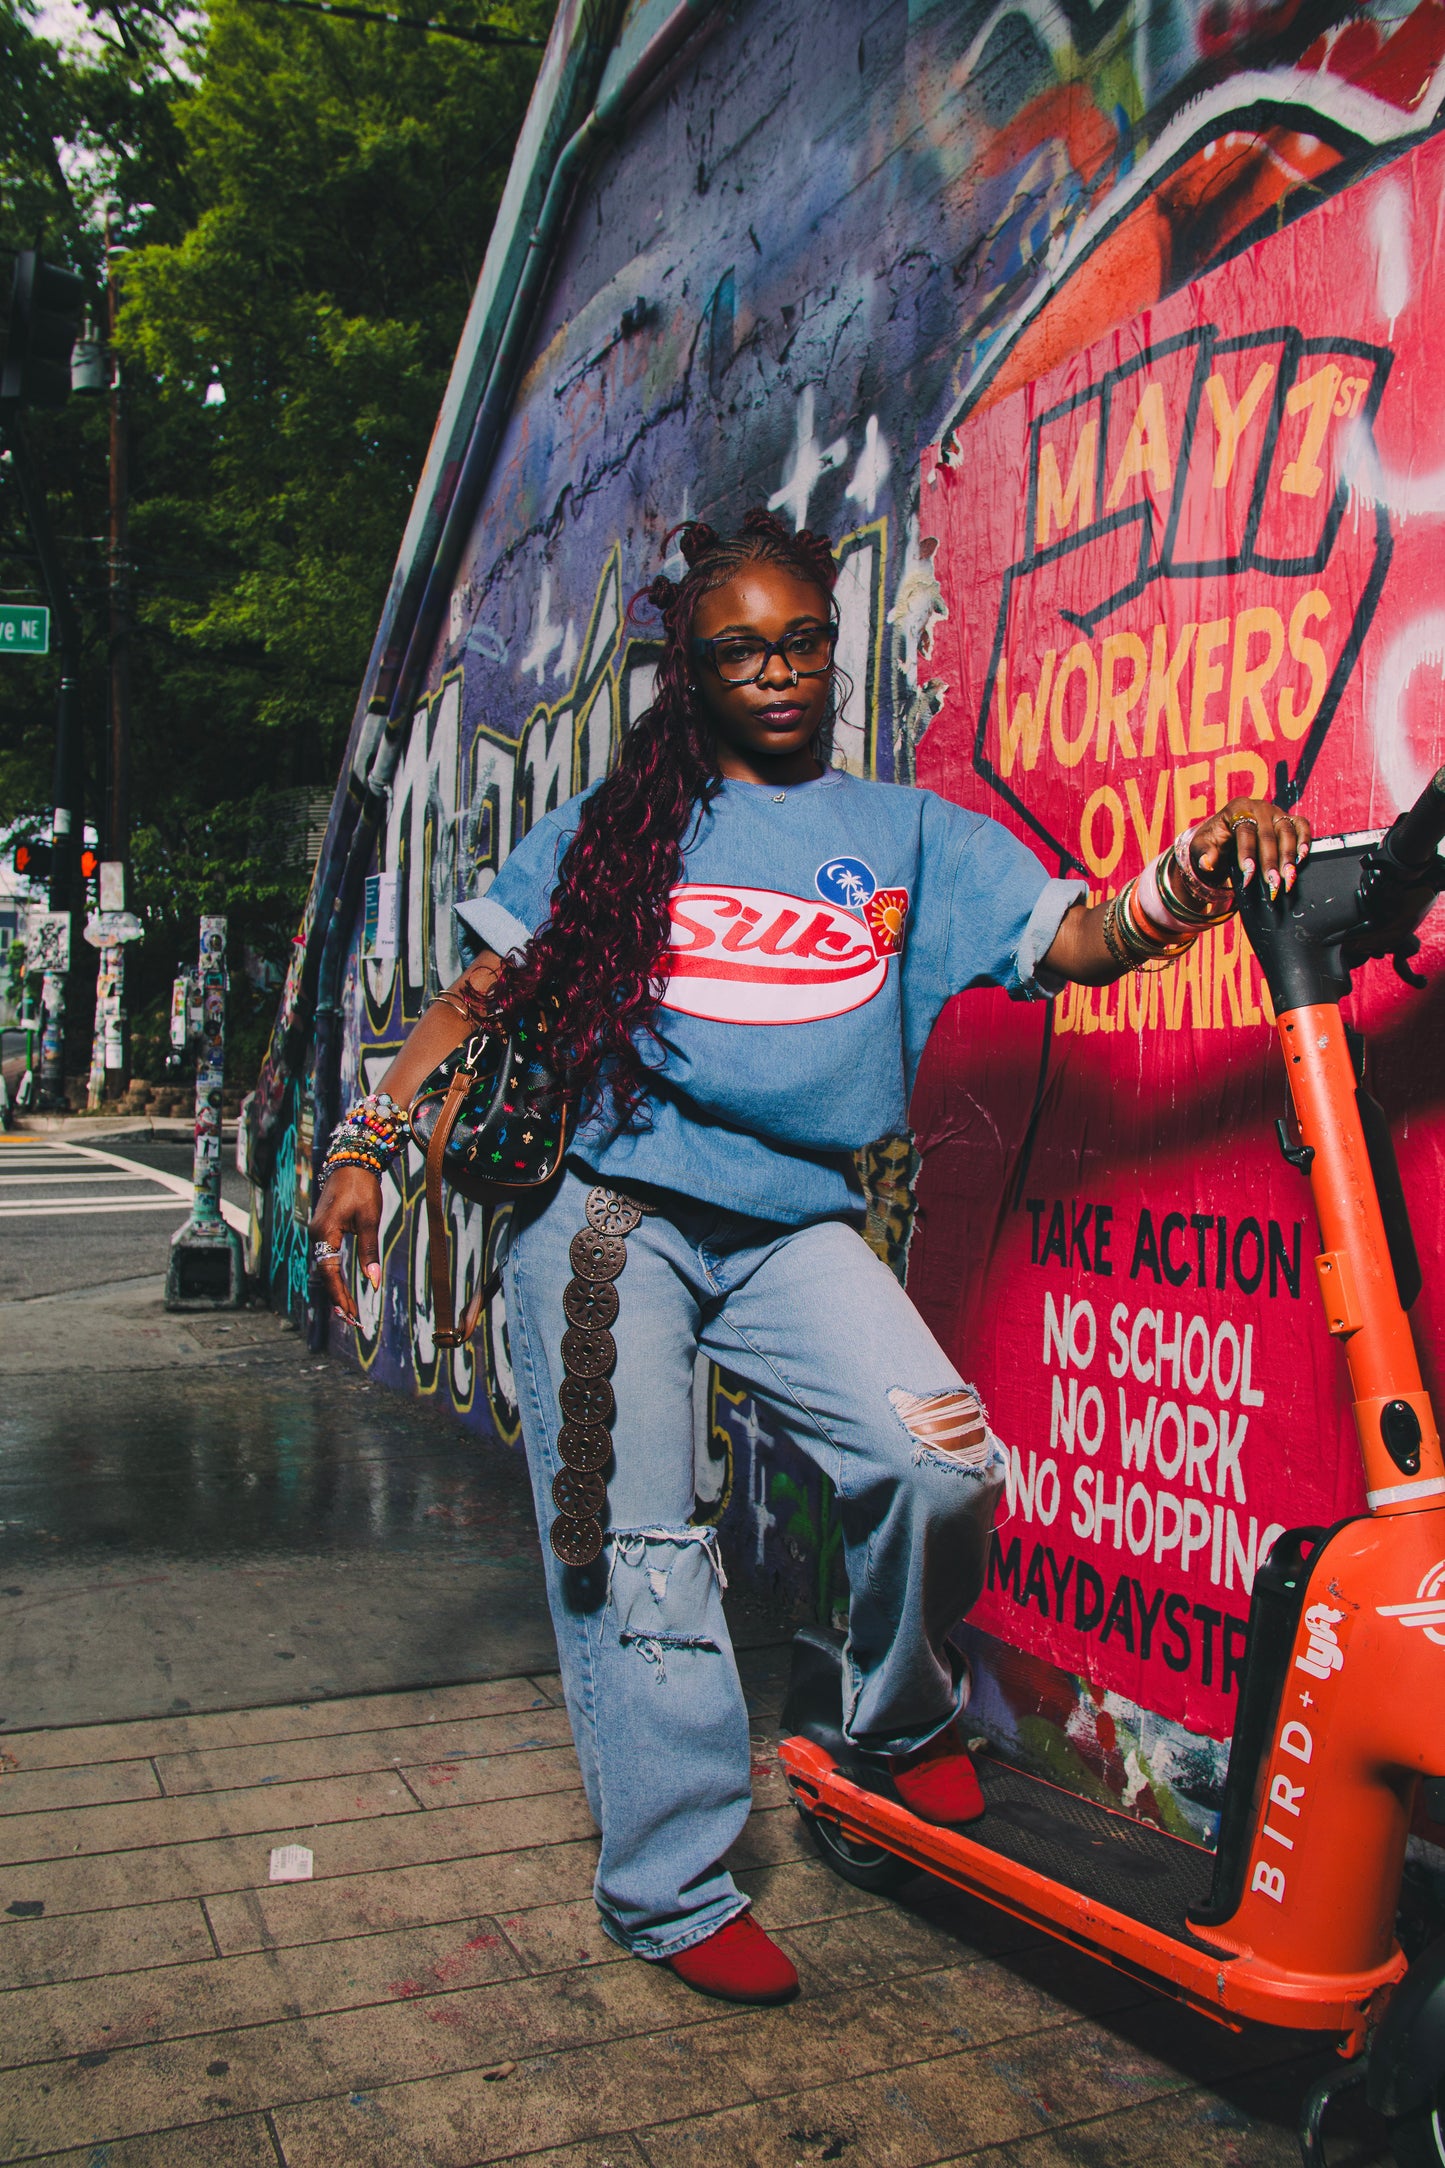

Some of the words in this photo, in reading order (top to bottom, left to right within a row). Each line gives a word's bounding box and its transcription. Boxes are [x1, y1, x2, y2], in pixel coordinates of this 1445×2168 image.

[1036, 363, 1274, 544] MAY
[21, 620, 40, 639] NE
[997, 589, 1332, 778] WORKERS
[666, 893, 876, 963] Silk
[1026, 1199, 1113, 1276] TAKE
[1130, 1206, 1304, 1299] ACTION
[1043, 1291, 1097, 1369] NO
[1108, 1306, 1265, 1406] SCHOOL
[1007, 1446, 1061, 1526] NO
[1050, 1375, 1106, 1456] NO
[1118, 1387, 1250, 1504] WORK
[1251, 1720, 1314, 1905] BIRD
[1295, 1602, 1347, 1680] lyft
